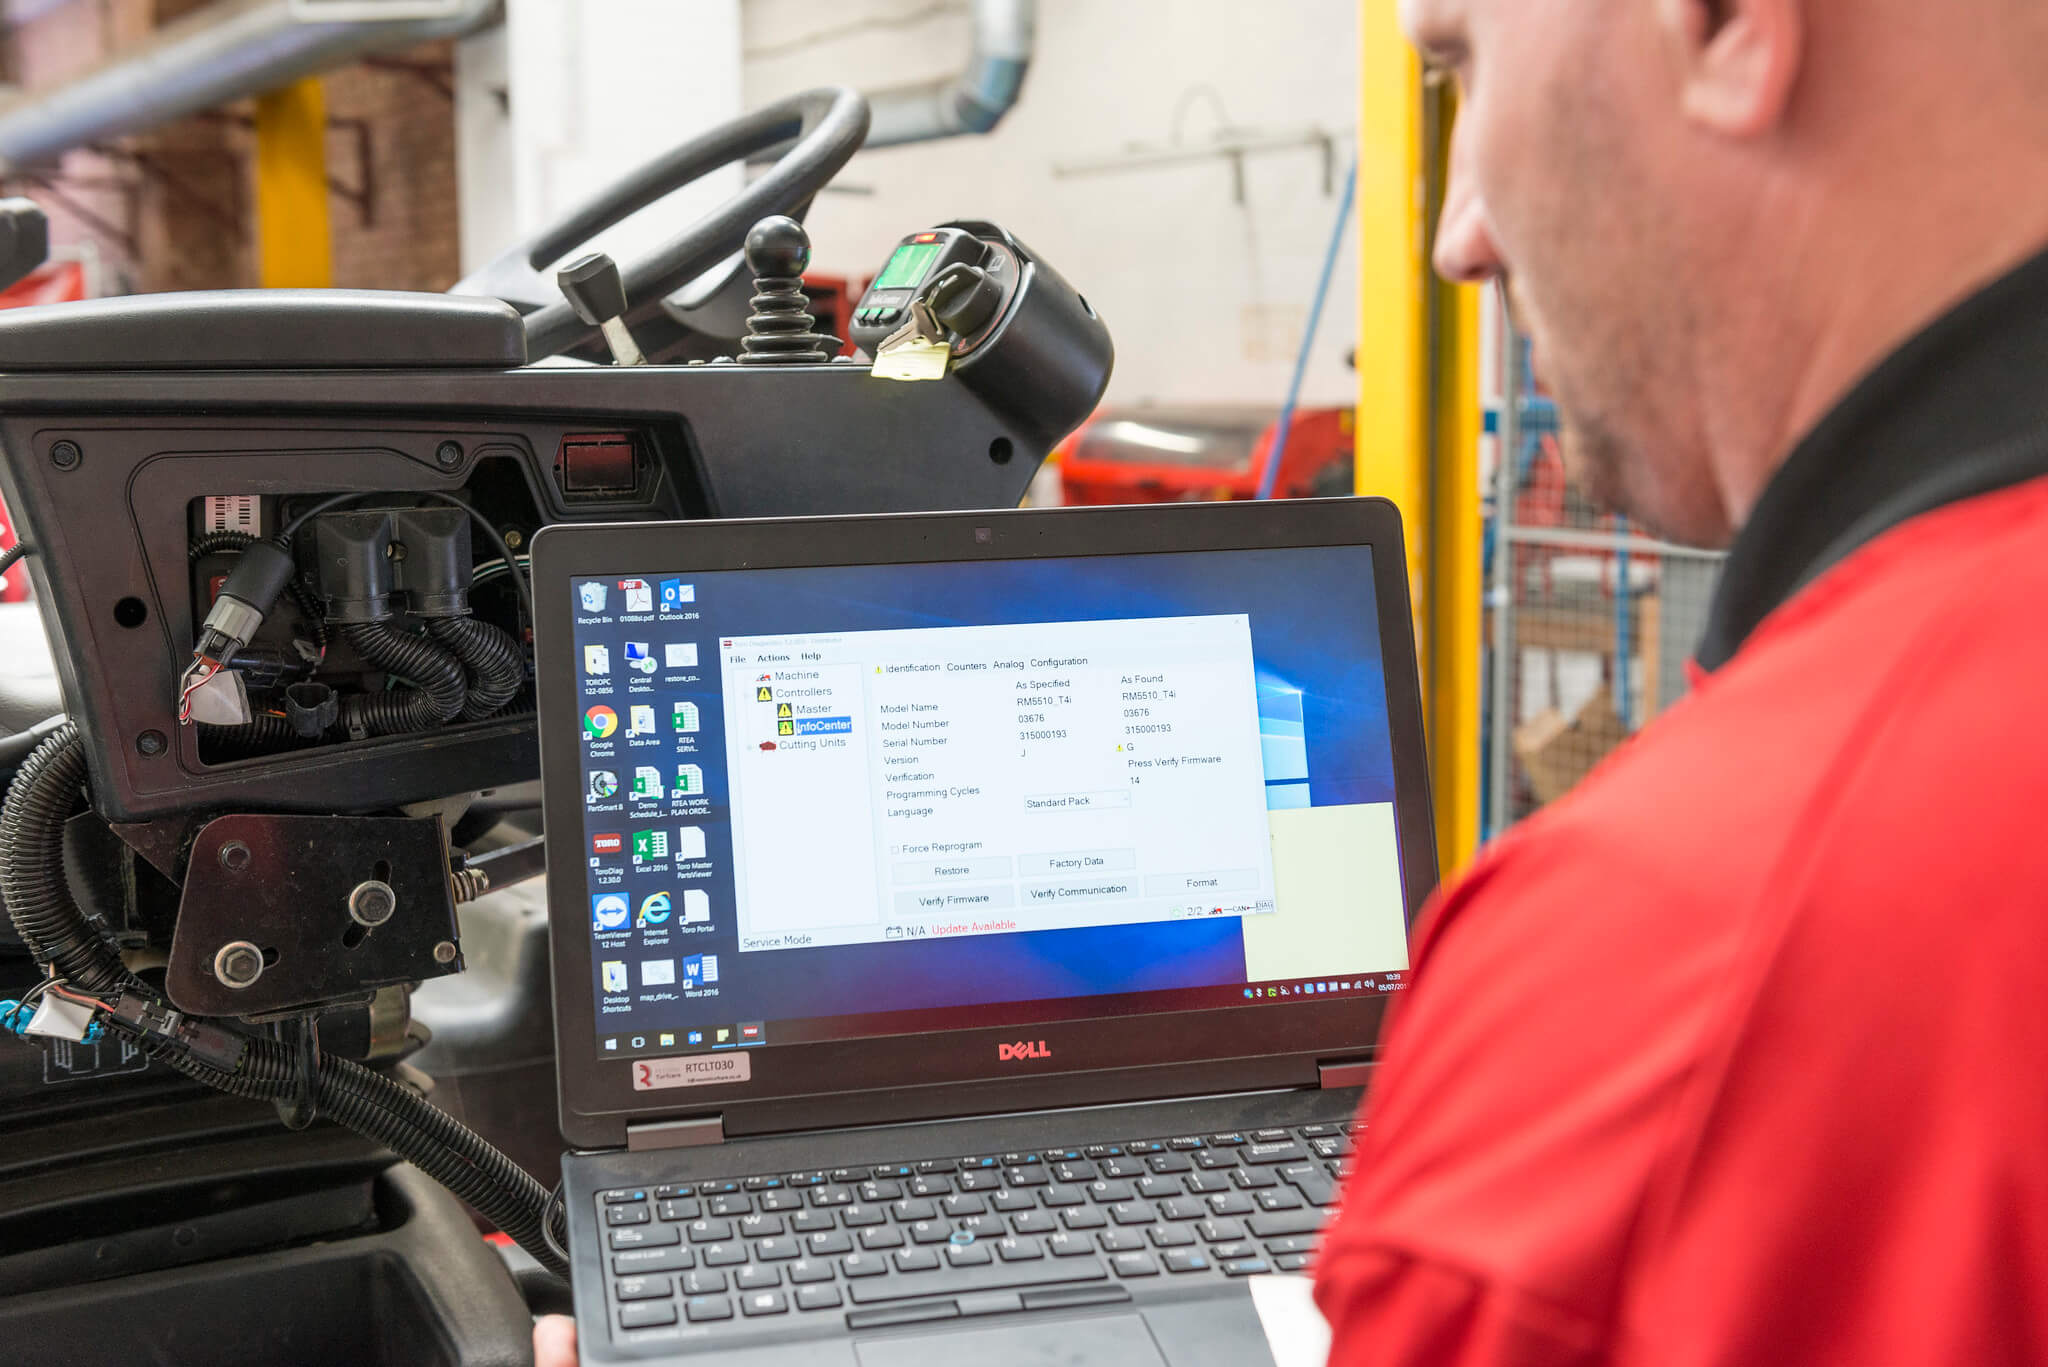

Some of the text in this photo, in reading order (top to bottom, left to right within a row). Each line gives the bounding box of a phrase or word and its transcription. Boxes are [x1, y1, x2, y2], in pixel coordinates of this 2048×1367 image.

[578, 616, 613, 625] Recycle Bin
[757, 654, 790, 662] Actions
[801, 652, 822, 661] Help
[886, 657, 1088, 673] Identification Counters Analog Configuration
[775, 672, 819, 681] Machine
[1121, 675, 1164, 684] As Found
[585, 678, 611, 686] TOROPC
[1016, 680, 1070, 691] As Specified
[776, 688, 832, 698] Controllers
[796, 705, 832, 714] Master
[880, 704, 938, 713] Model Name
[1124, 708, 1150, 718] 03676
[1018, 714, 1045, 723] 03676
[796, 721, 851, 732] InfoCenter
[881, 720, 950, 731] Model Number
[1125, 724, 1172, 734] 315000193
[1019, 730, 1067, 740] 315000193
[590, 741, 613, 750] Google
[779, 739, 847, 751] Cutting Units
[883, 738, 947, 748] Serial Number
[1126, 743, 1134, 752] G
[590, 750, 615, 758] Chrome
[884, 756, 919, 765] Version
[1128, 755, 1222, 768] Press Verify Firmware
[885, 773, 934, 782] Verification
[1130, 776, 1140, 785] 14
[886, 787, 980, 801] Programming Cycles
[688, 798, 709, 806] WORK
[1026, 797, 1090, 809] Standard Pack
[588, 804, 618, 812] PartSmart
[671, 808, 688, 816] PLAN
[888, 807, 934, 818] Language
[595, 838, 620, 848] TORO
[902, 841, 983, 853] Force Reprogram
[1049, 856, 1104, 869] Factory Data
[595, 867, 624, 876] ToroDiag
[636, 864, 668, 873] Excel 2016
[934, 867, 970, 876] Restore
[677, 870, 712, 879] PartsViewer
[1186, 878, 1218, 888] Format
[1030, 884, 1128, 900] Verify Communication
[919, 895, 990, 907] Verify Firmware
[1256, 901, 1273, 910] DIAG
[1232, 904, 1247, 912] CAN
[682, 926, 696, 934] Toro
[906, 926, 926, 937] N/A
[932, 920, 1017, 937] Update Available
[593, 931, 632, 940] TeamViewer
[610, 940, 626, 948] Host
[643, 937, 669, 946] Explorer
[743, 935, 812, 948] Service Mode
[685, 988, 719, 998] Word 2016
[603, 996, 630, 1005] Desktop
[602, 1004, 632, 1013] Shortcuts
[998, 1040, 1052, 1061] DELL
[685, 1060, 734, 1072] RTCLT030
